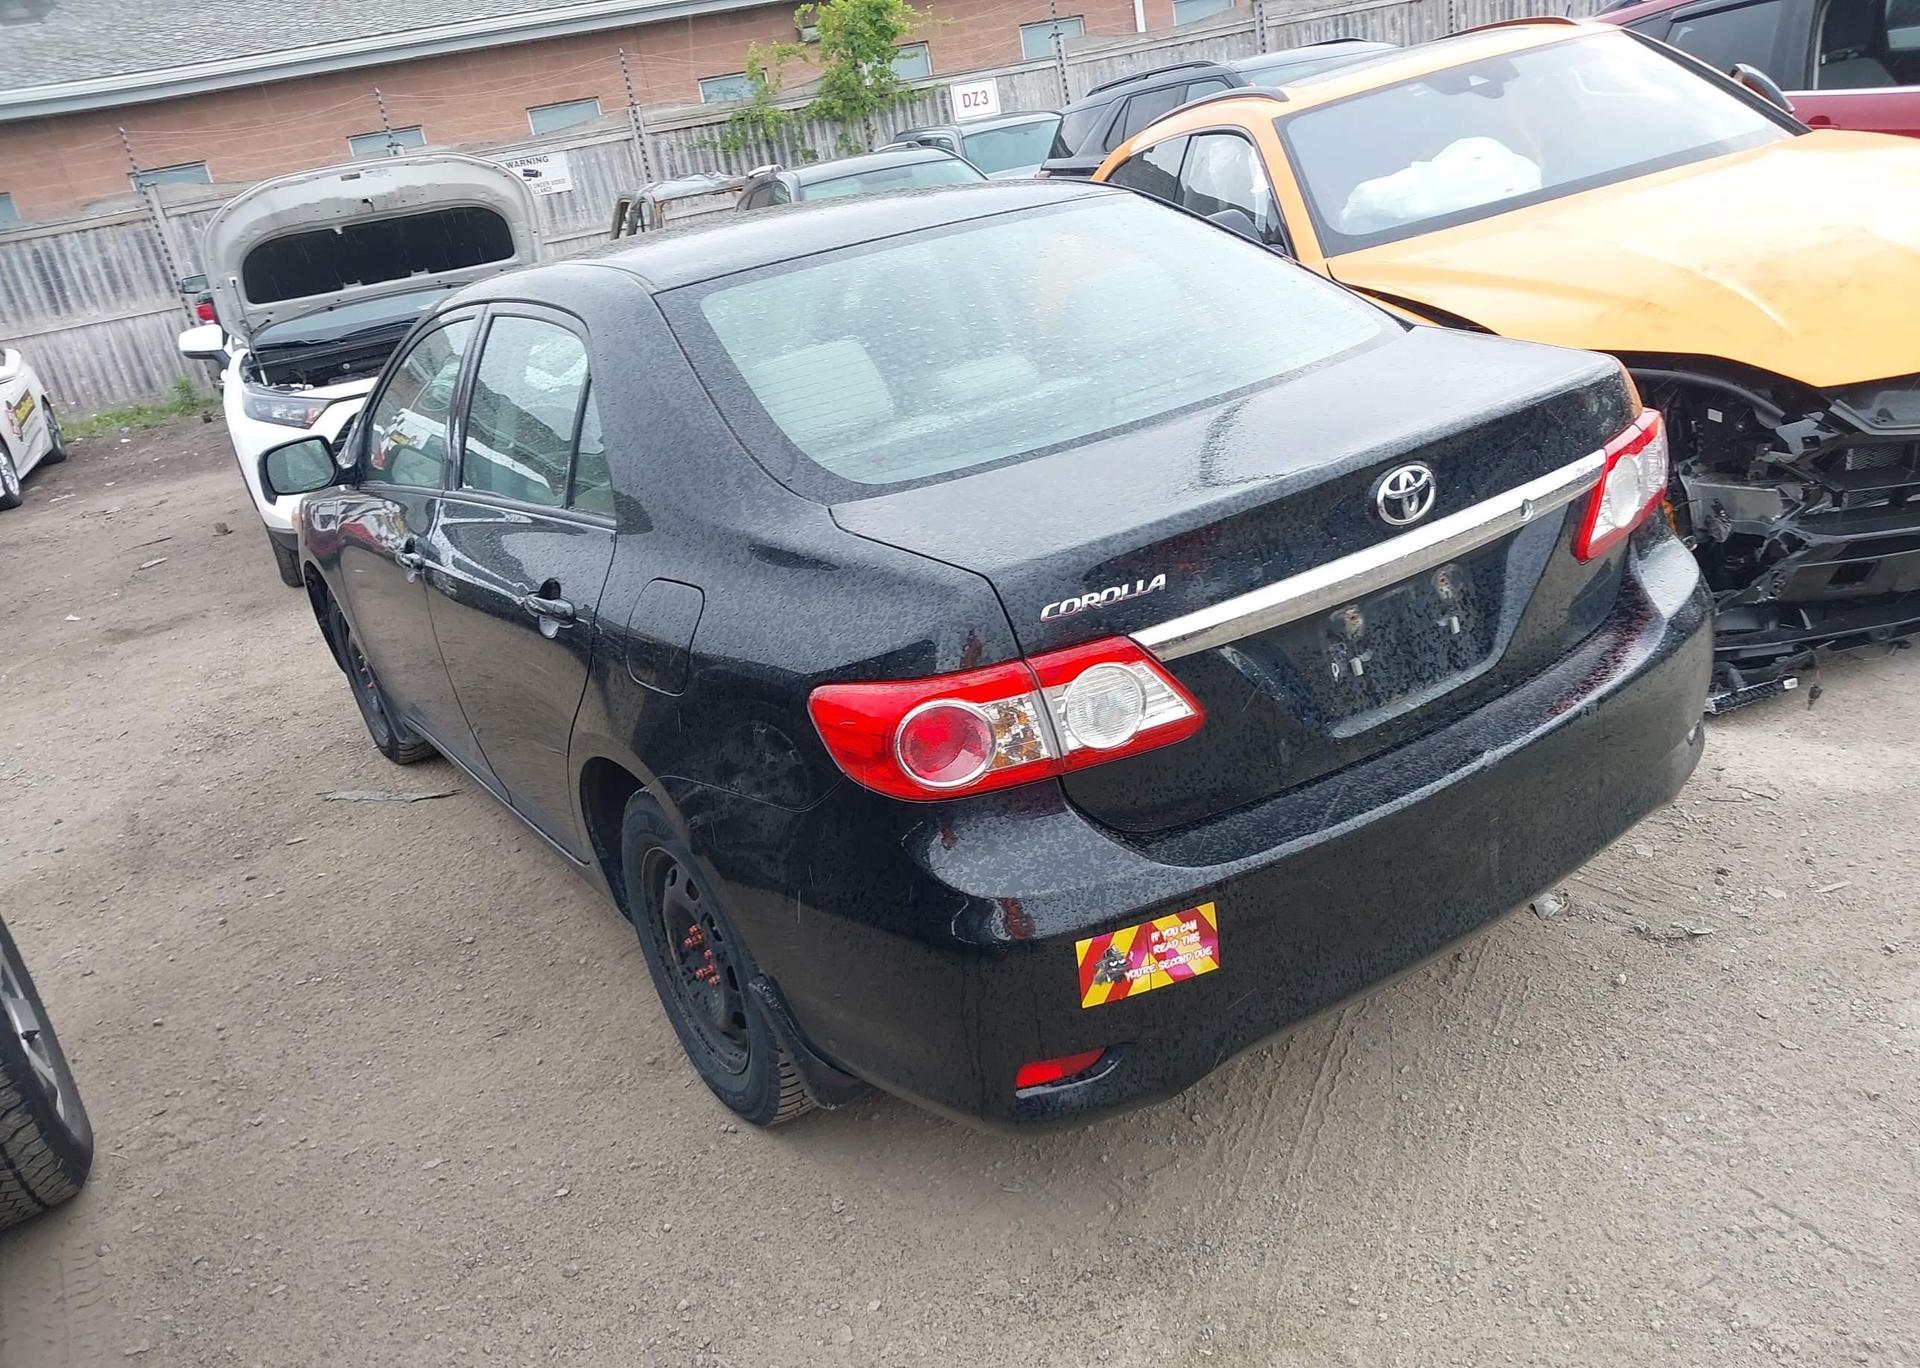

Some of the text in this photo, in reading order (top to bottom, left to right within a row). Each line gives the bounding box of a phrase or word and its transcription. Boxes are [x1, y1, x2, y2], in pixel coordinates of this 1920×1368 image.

[961, 90, 989, 108] DZ3
[505, 156, 549, 168] WARNING
[1040, 574, 1166, 622] COROLLA
[1151, 920, 1197, 942] IF YOU CAN
[1153, 932, 1200, 954] READ THIS
[1158, 954, 1192, 969] SECOND
[1194, 946, 1213, 958] DUE
